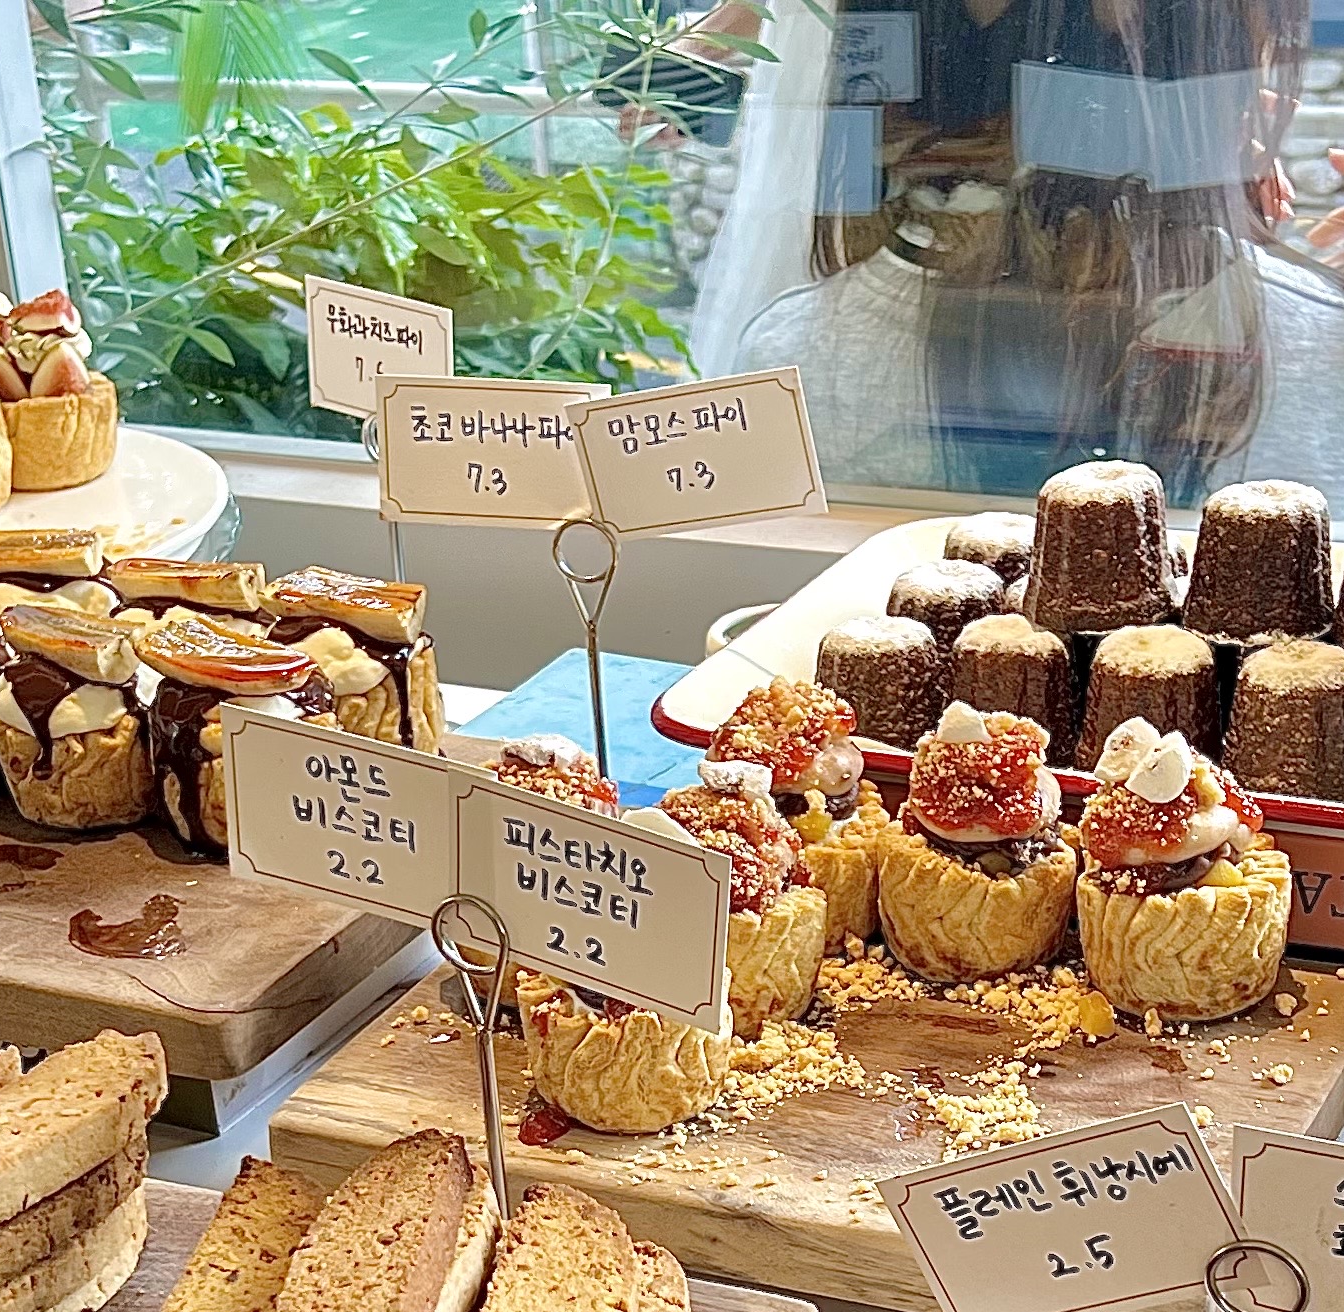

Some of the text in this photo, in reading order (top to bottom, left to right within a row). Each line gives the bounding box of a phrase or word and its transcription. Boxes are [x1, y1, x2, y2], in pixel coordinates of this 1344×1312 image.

[467, 462, 507, 496] 7.3
[666, 461, 715, 492] 7.3
[305, 754, 391, 804] 아몬드
[292, 795, 416, 854] 비스코티
[327, 850, 384, 885] 2.2
[502, 817, 654, 896] 피스타치오
[517, 862, 638, 930] 비스코티
[546, 926, 606, 967] 2.2
[934, 1144, 1195, 1240] 플레인 휘낭시에
[1047, 1234, 1114, 1278] 2.5
